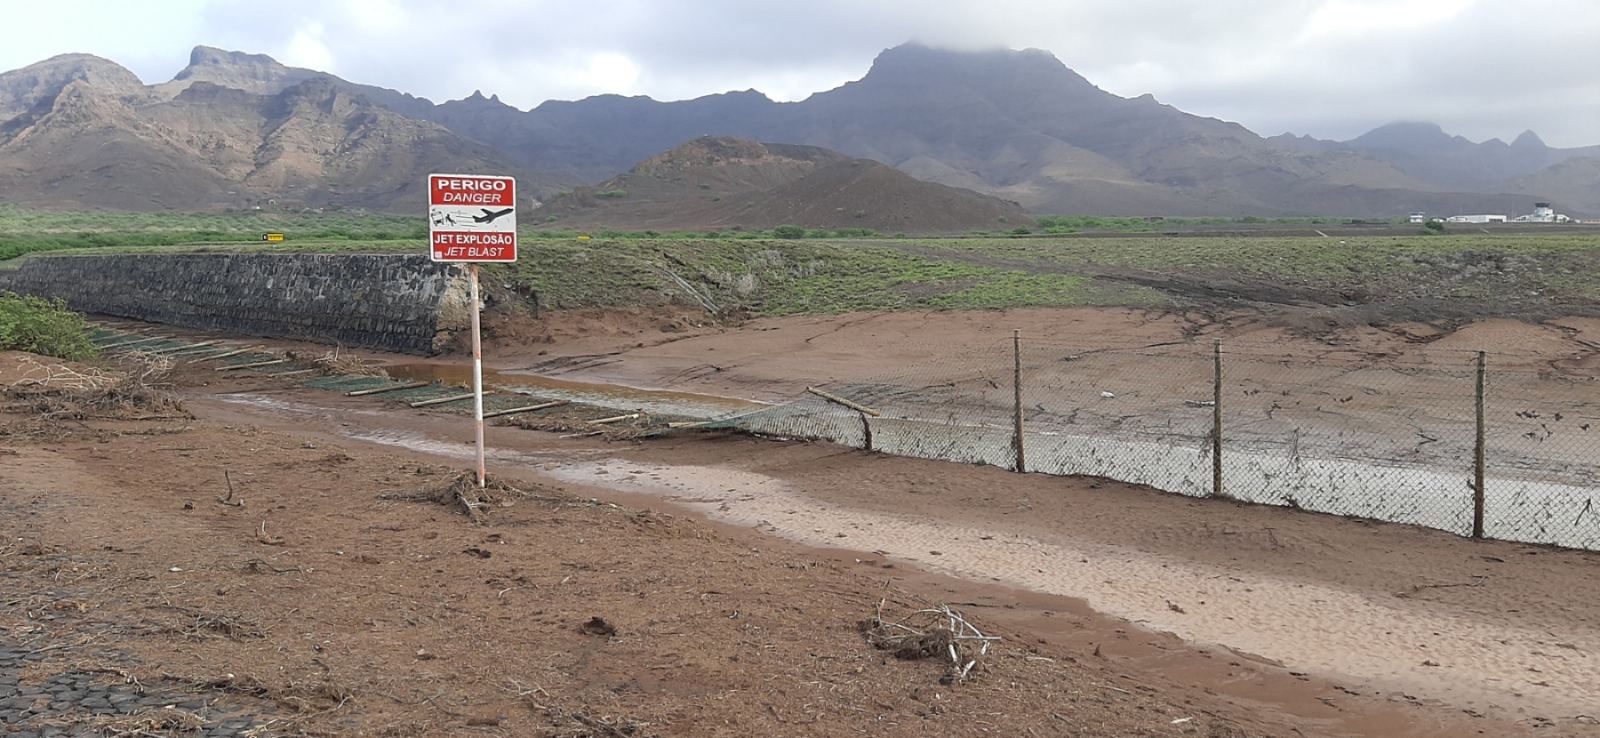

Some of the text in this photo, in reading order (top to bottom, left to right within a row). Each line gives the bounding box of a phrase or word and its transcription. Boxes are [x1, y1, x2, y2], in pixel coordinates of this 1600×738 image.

[438, 179, 506, 191] PERIGO
[443, 192, 502, 203] DANGER
[434, 233, 512, 244] JET EXPLOSÃO
[444, 246, 505, 257] JET BLAST
